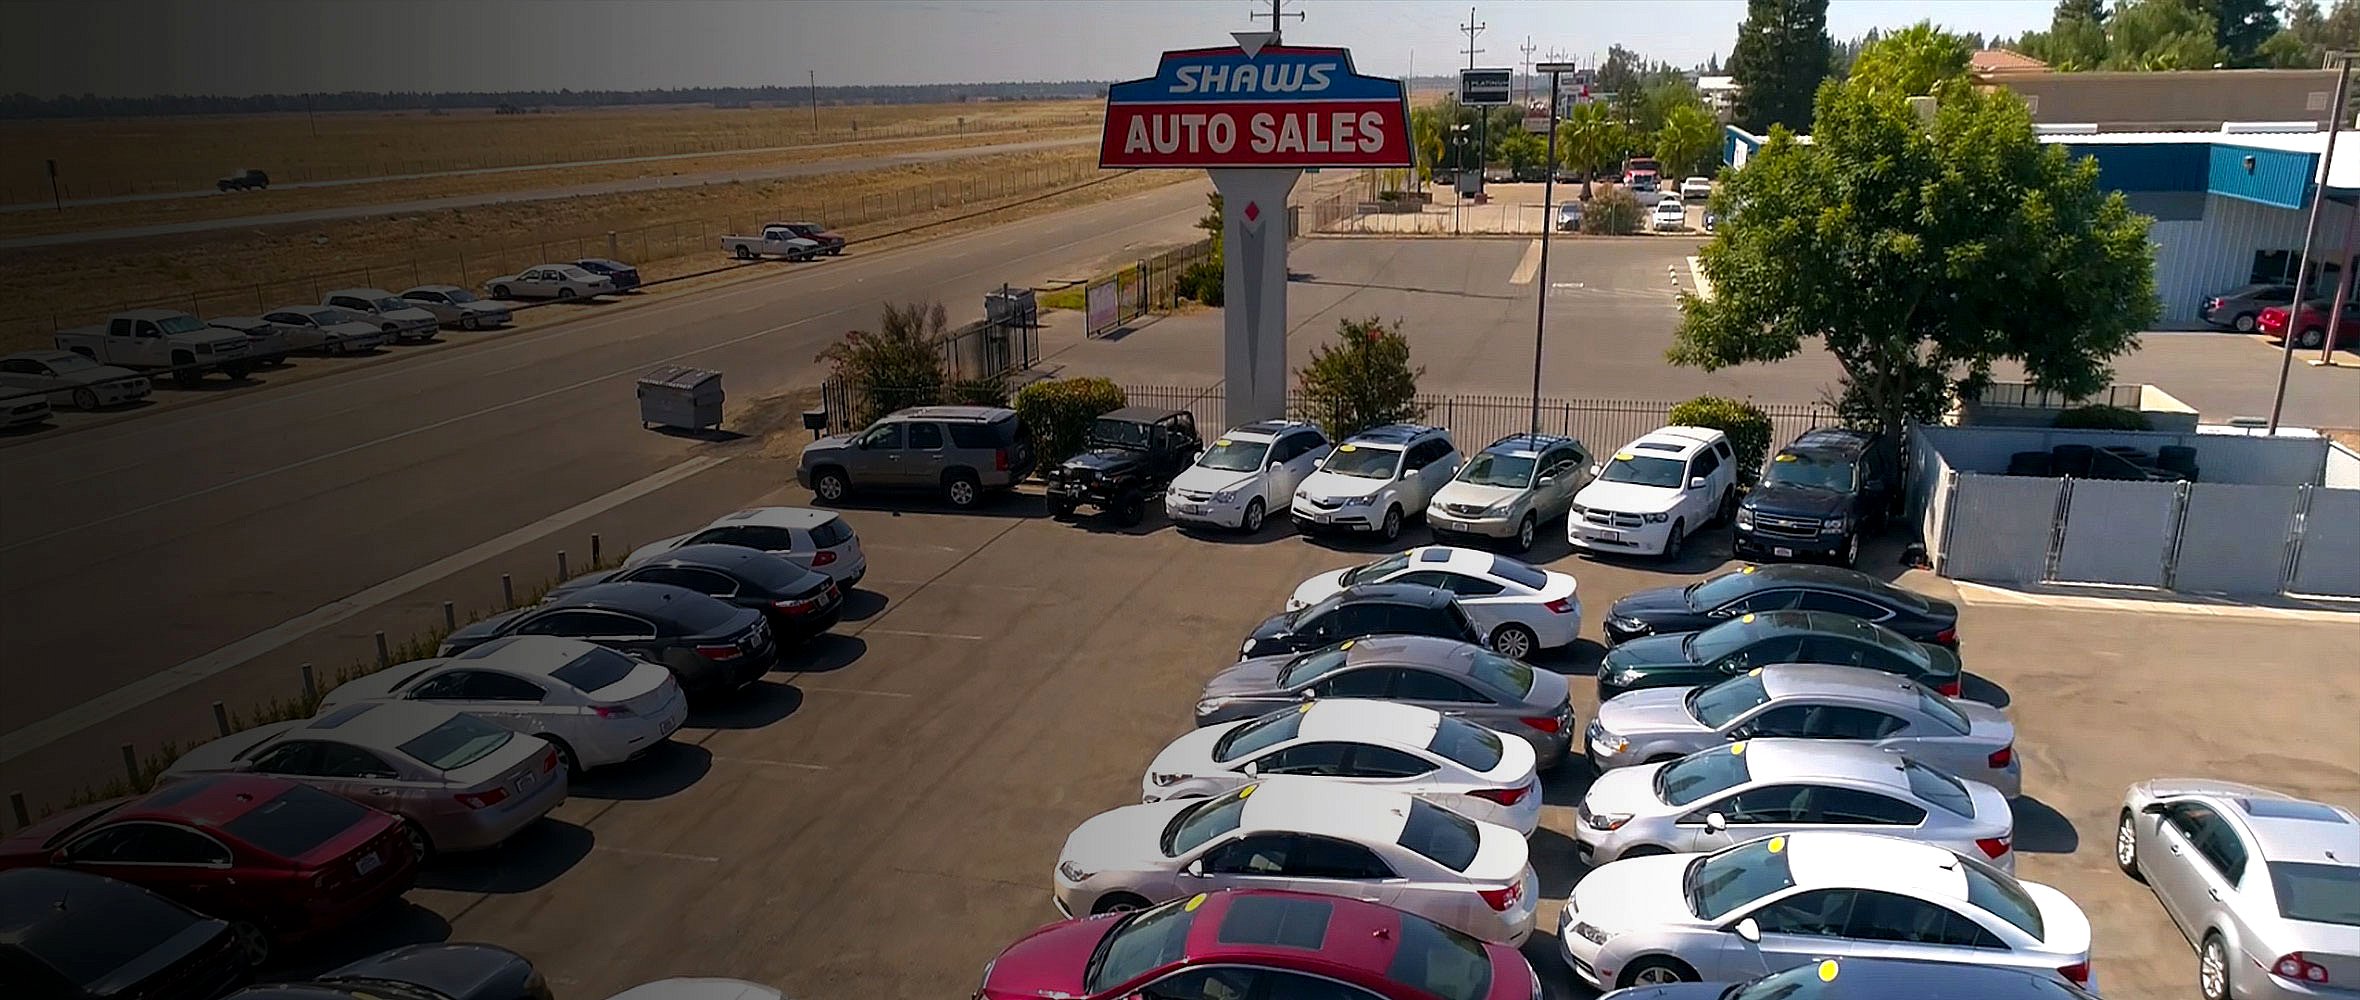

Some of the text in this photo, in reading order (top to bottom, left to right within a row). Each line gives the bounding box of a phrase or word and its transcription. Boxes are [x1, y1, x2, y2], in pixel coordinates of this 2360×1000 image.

[1169, 63, 1337, 93] SHAWS
[1124, 111, 1385, 154] AUTO SALES
